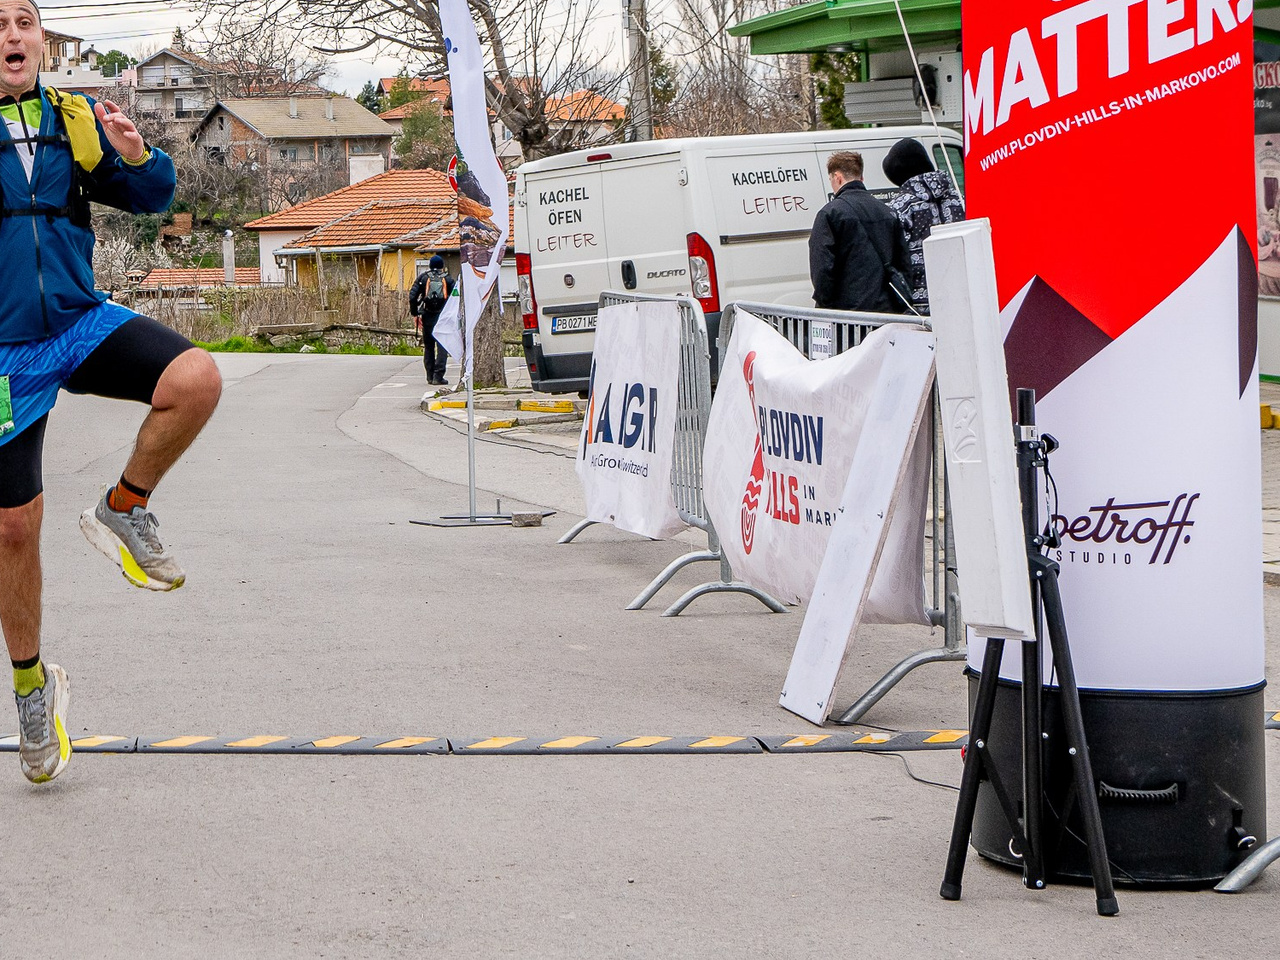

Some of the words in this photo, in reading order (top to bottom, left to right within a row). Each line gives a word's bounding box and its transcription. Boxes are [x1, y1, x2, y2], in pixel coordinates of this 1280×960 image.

[980, 52, 1241, 172] WWW.PLOVDIV-HILLS-IN-MARKOVO.COM
[732, 167, 808, 186] KACHELÖFEN
[539, 187, 590, 206] KACHEL
[743, 195, 809, 215] LEITER
[548, 209, 582, 226] ÖFEN
[537, 233, 597, 252] LEITER
[647, 269, 687, 279] DUCATO
[568, 317, 586, 329] 0271
[759, 405, 824, 466] PLOVDIV
[804, 484, 816, 500] IN
[1056, 551, 1133, 565] STUDIO
